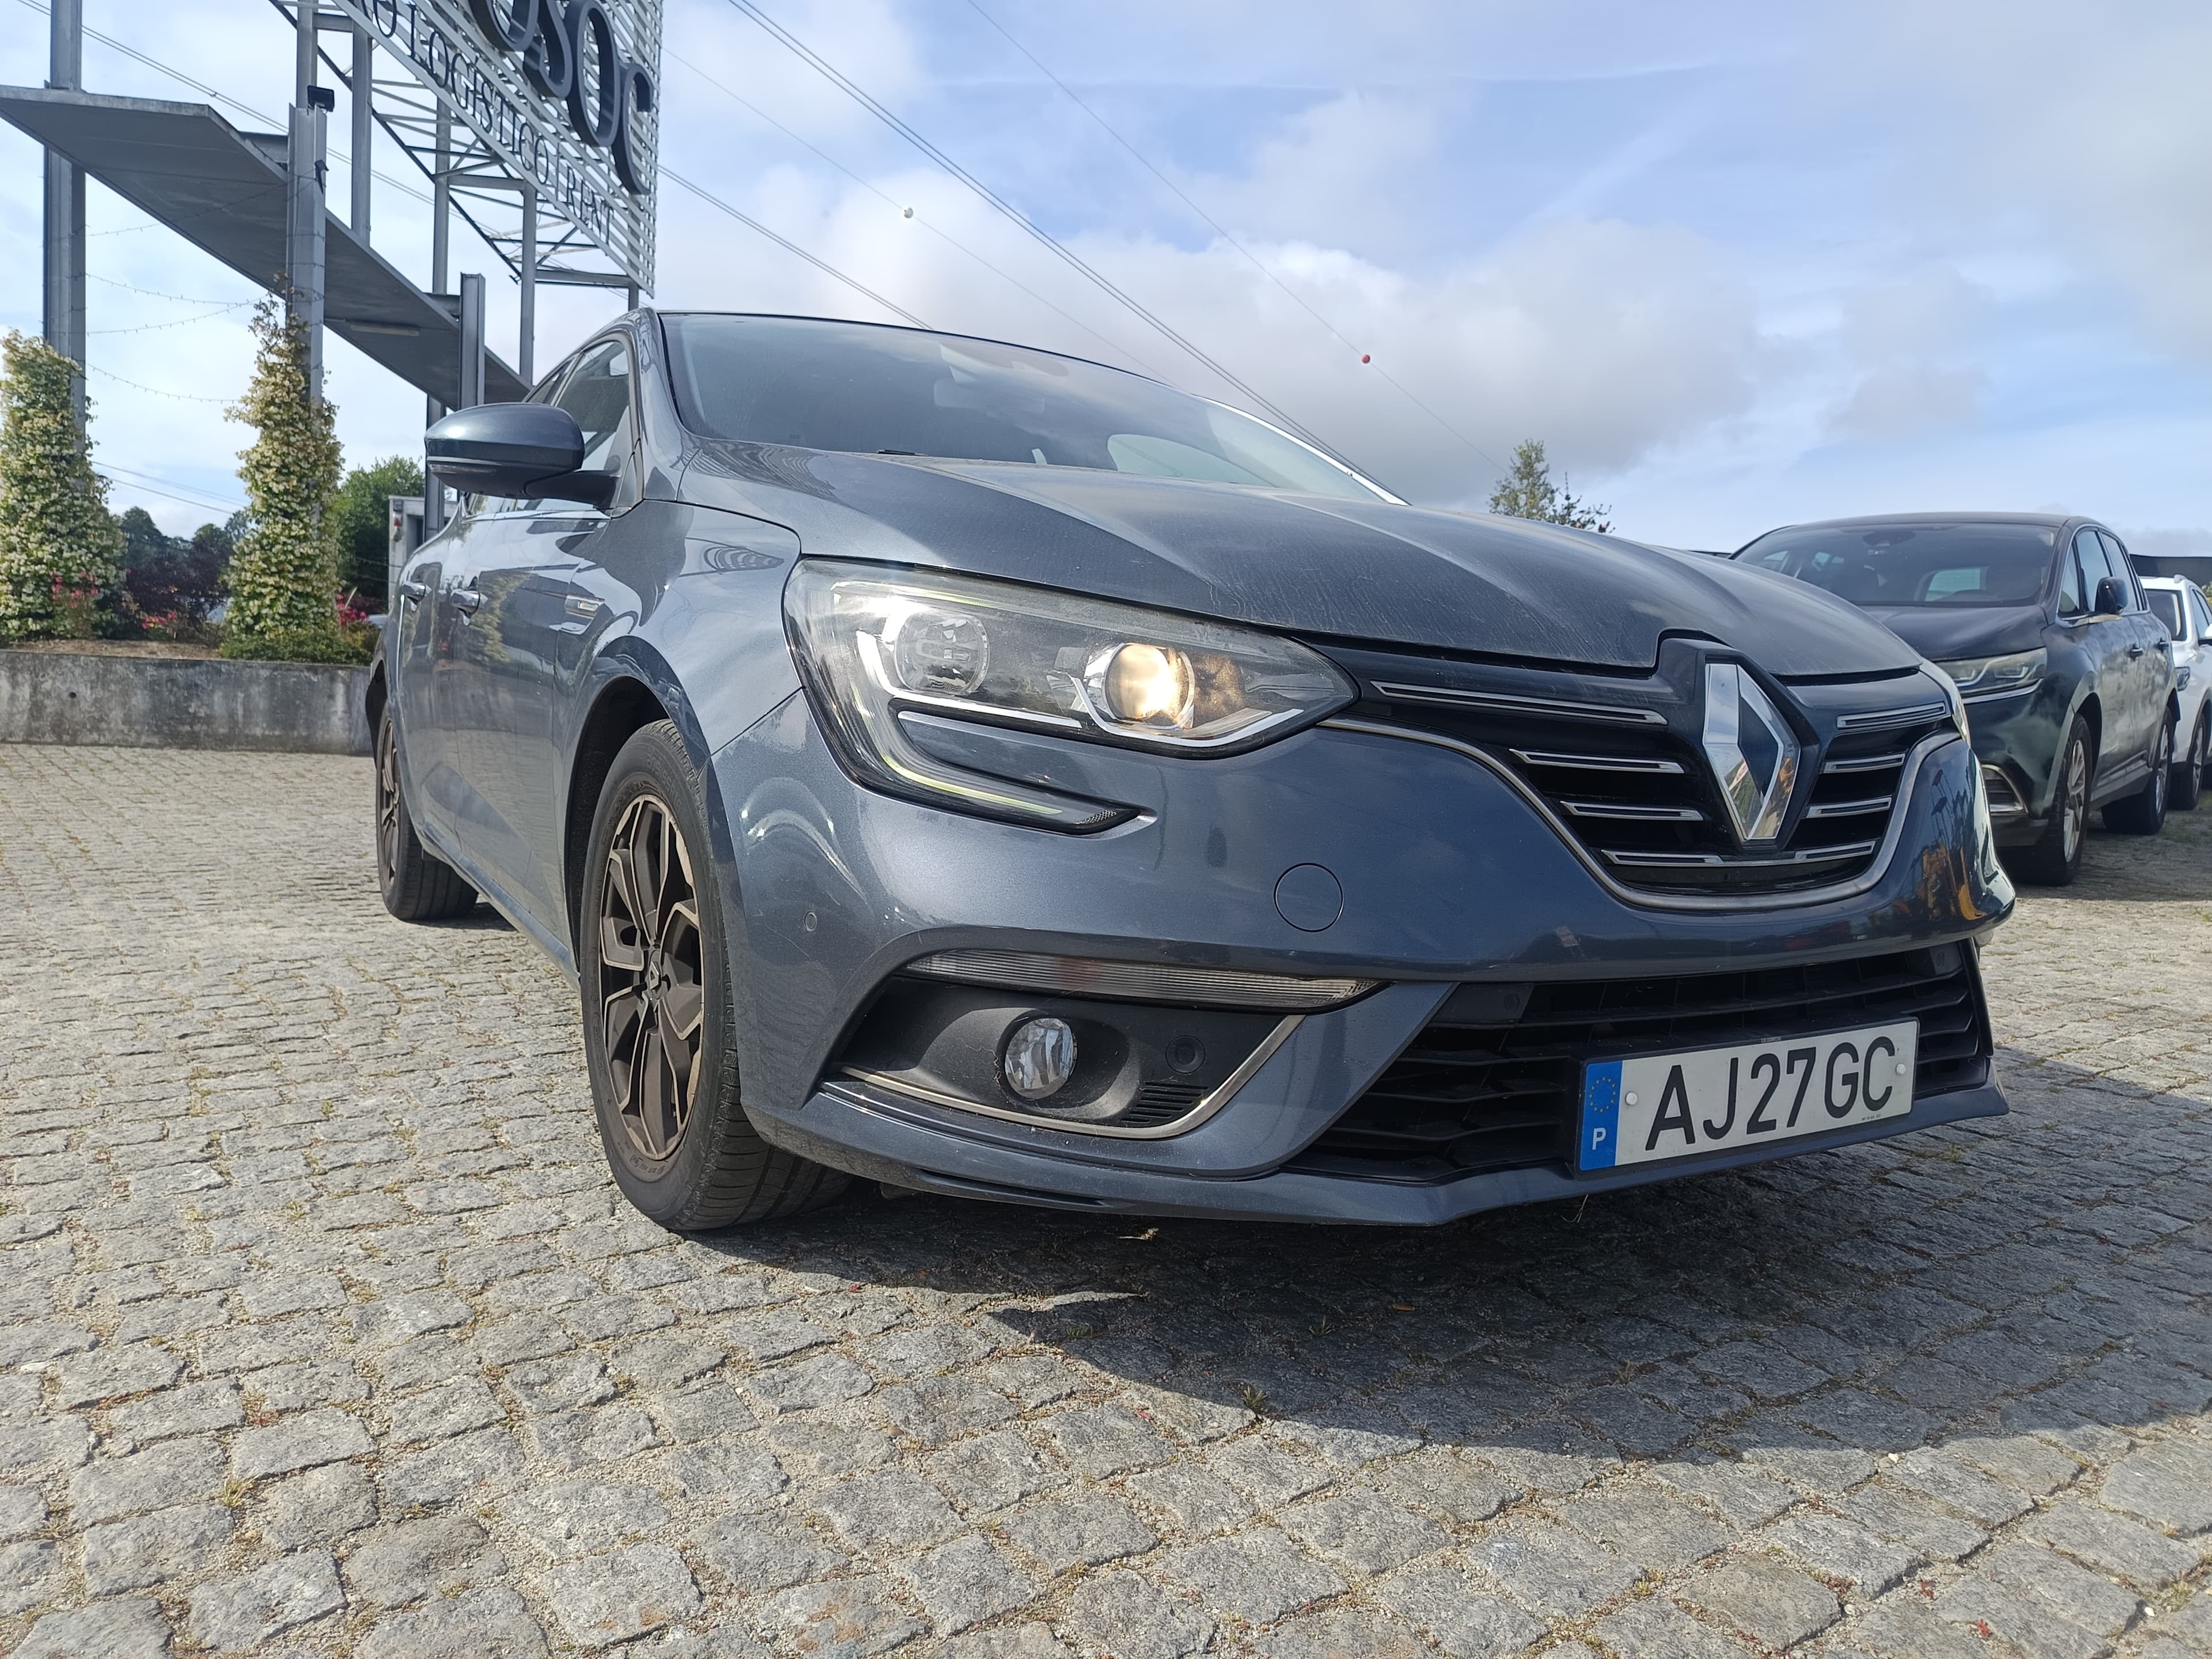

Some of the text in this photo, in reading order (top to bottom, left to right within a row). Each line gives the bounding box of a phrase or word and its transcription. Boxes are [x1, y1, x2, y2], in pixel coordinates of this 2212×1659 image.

[566, 165, 614, 244] RENT
[1645, 1036, 1895, 1151] AJ27GC
[1592, 1127, 1607, 1150] P
